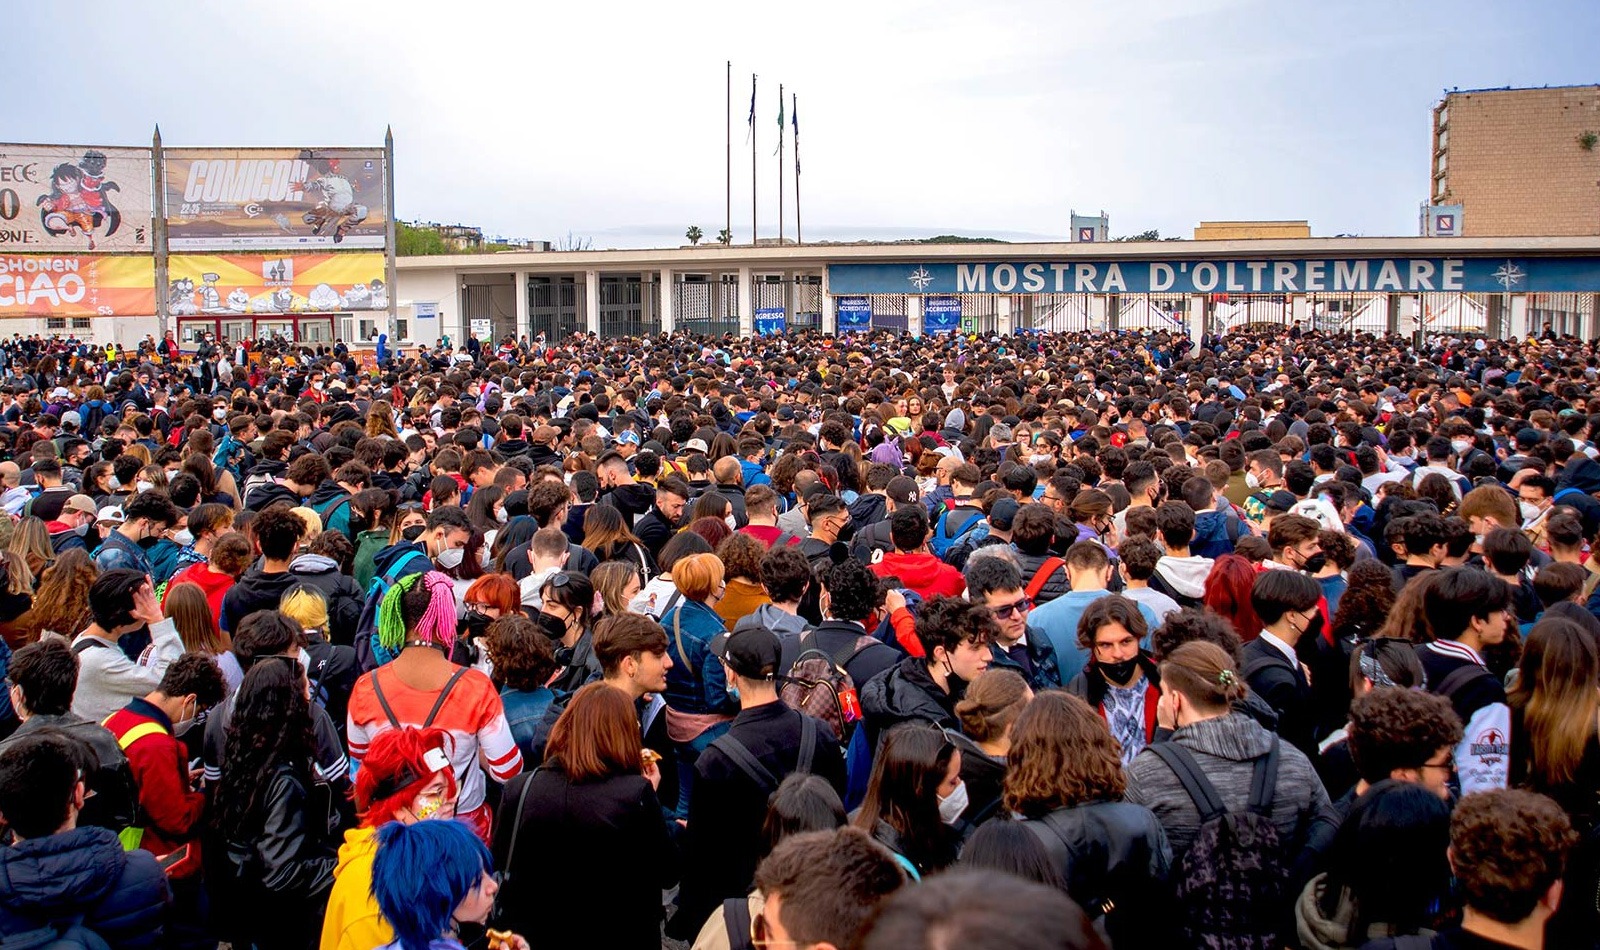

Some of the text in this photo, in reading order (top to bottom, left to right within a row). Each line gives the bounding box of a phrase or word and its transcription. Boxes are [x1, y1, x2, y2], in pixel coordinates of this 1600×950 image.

[184, 159, 310, 202] COMICON
[0, 272, 86, 307] CIAO
[956, 260, 1464, 292] MOSTRA D'OLTREMARE
[755, 312, 784, 320] NGRESSO
